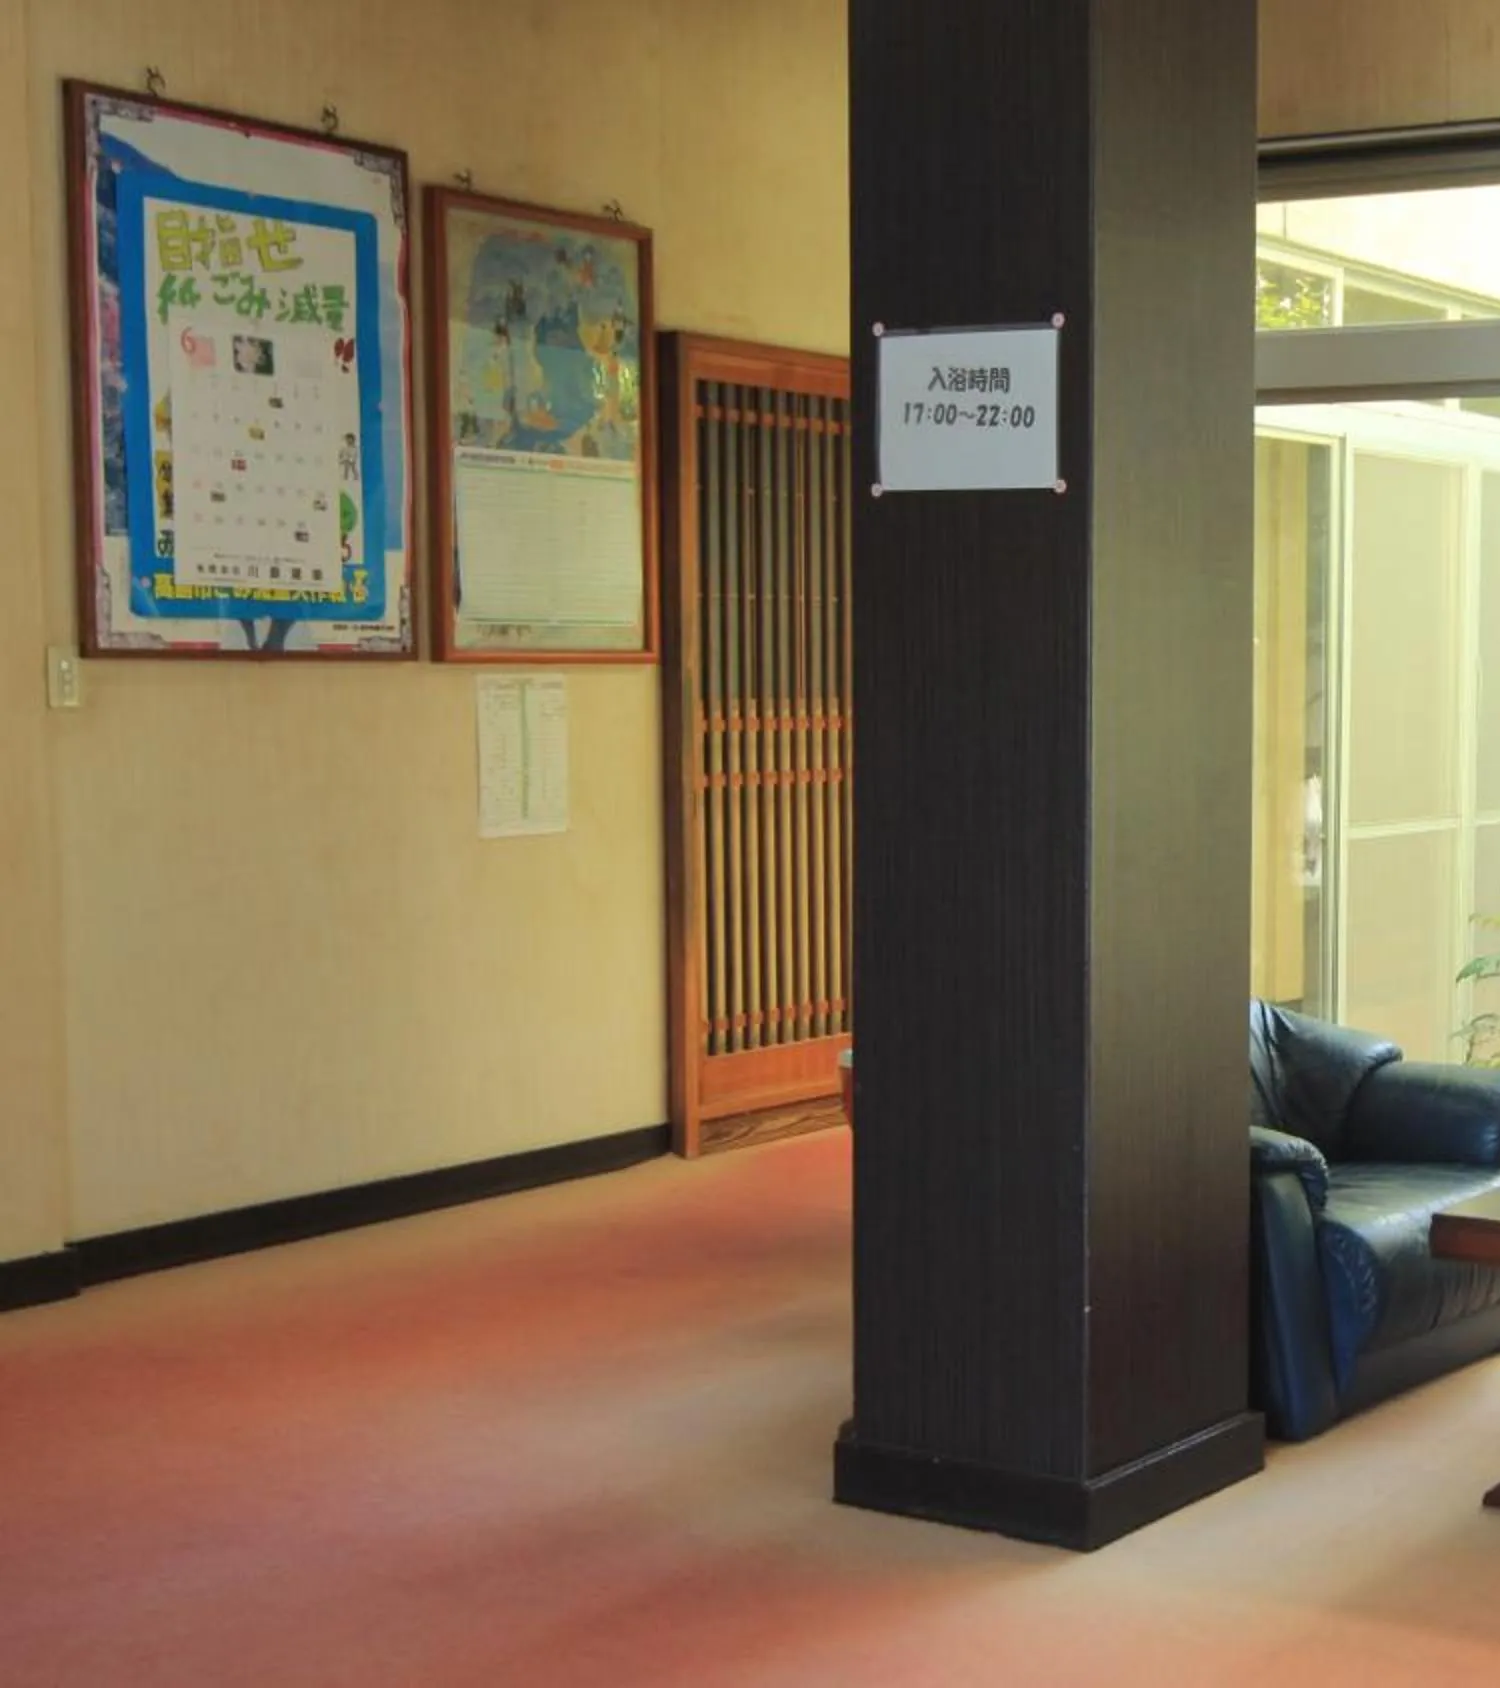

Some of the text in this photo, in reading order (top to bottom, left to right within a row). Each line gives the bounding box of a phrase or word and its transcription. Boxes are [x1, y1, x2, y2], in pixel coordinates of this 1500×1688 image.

[157, 209, 304, 272] 目指せ
[928, 366, 1010, 393] 入浴時間
